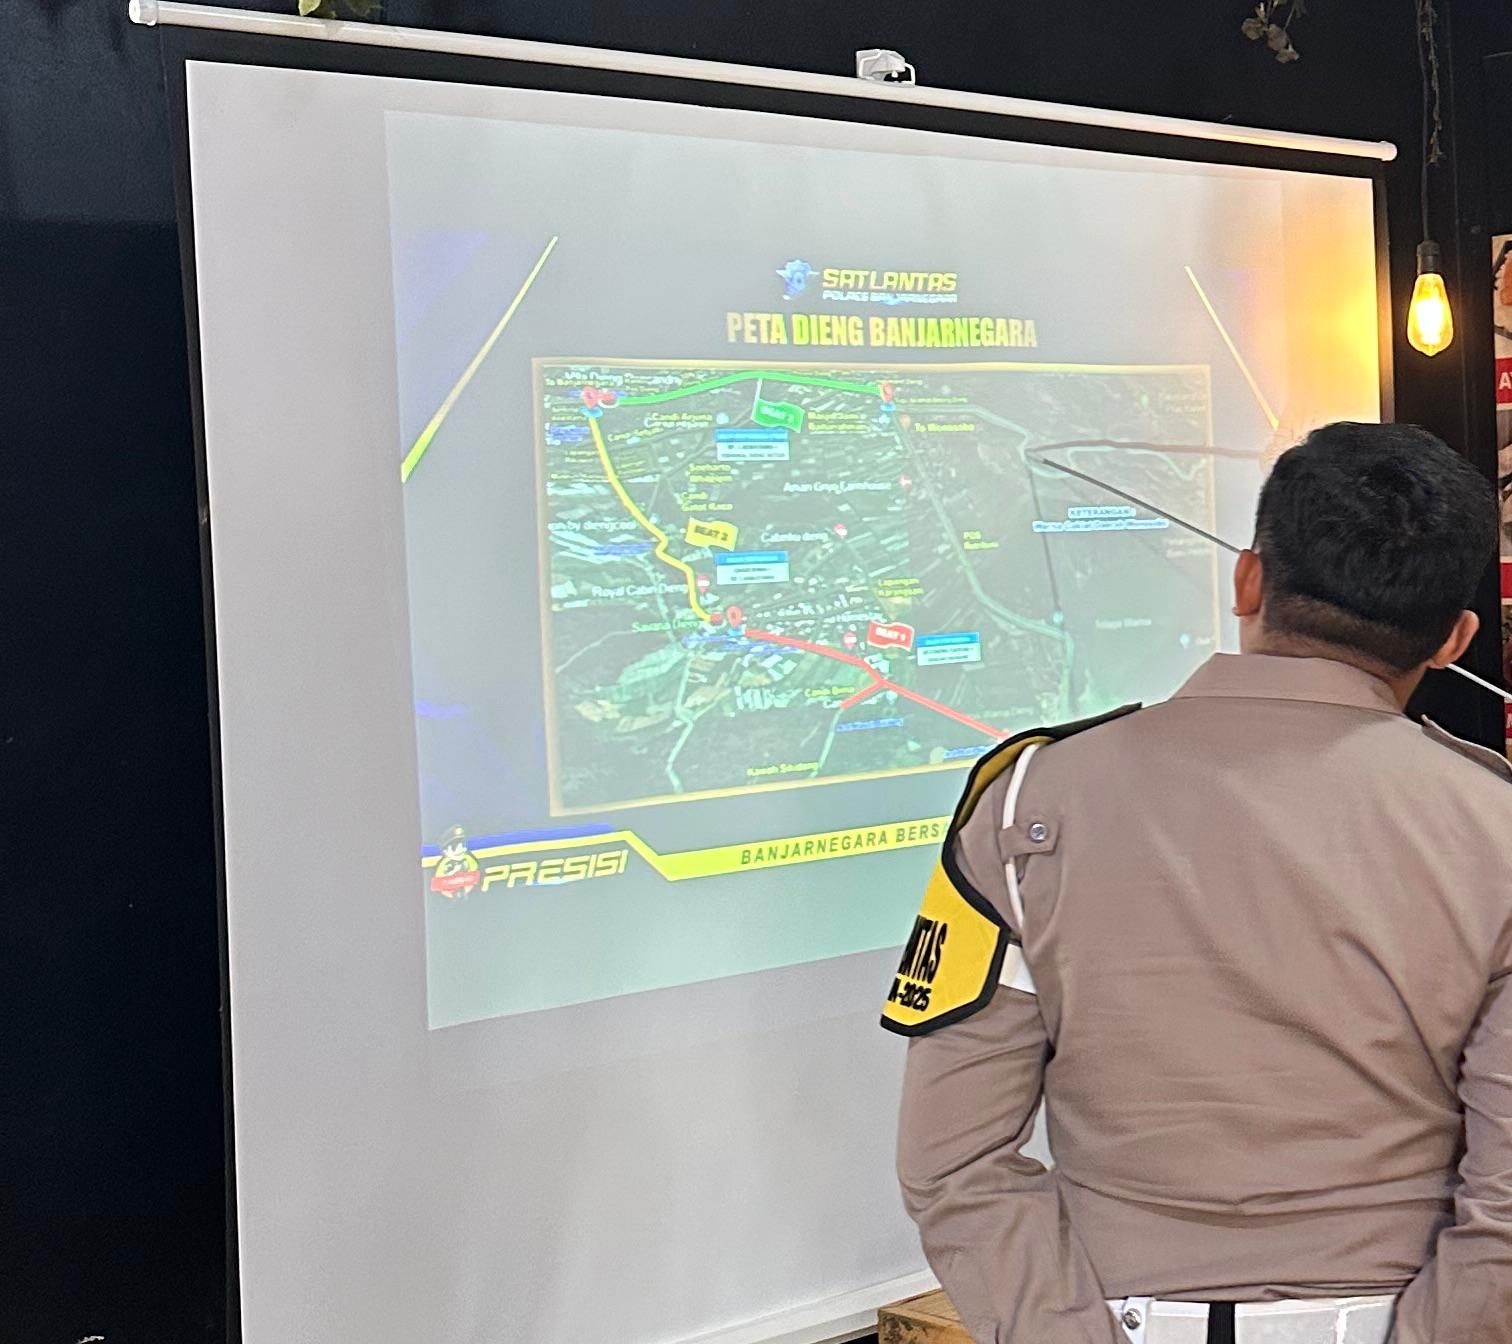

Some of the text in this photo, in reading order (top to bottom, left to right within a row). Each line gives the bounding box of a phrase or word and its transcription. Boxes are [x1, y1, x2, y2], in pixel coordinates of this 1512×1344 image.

[822, 268, 958, 292] SATLANTAS
[726, 312, 1038, 349] PETA DIENG BANJARNEGARA
[740, 830, 888, 866] BANJARNEGARA
[480, 849, 629, 892] PRESISI
